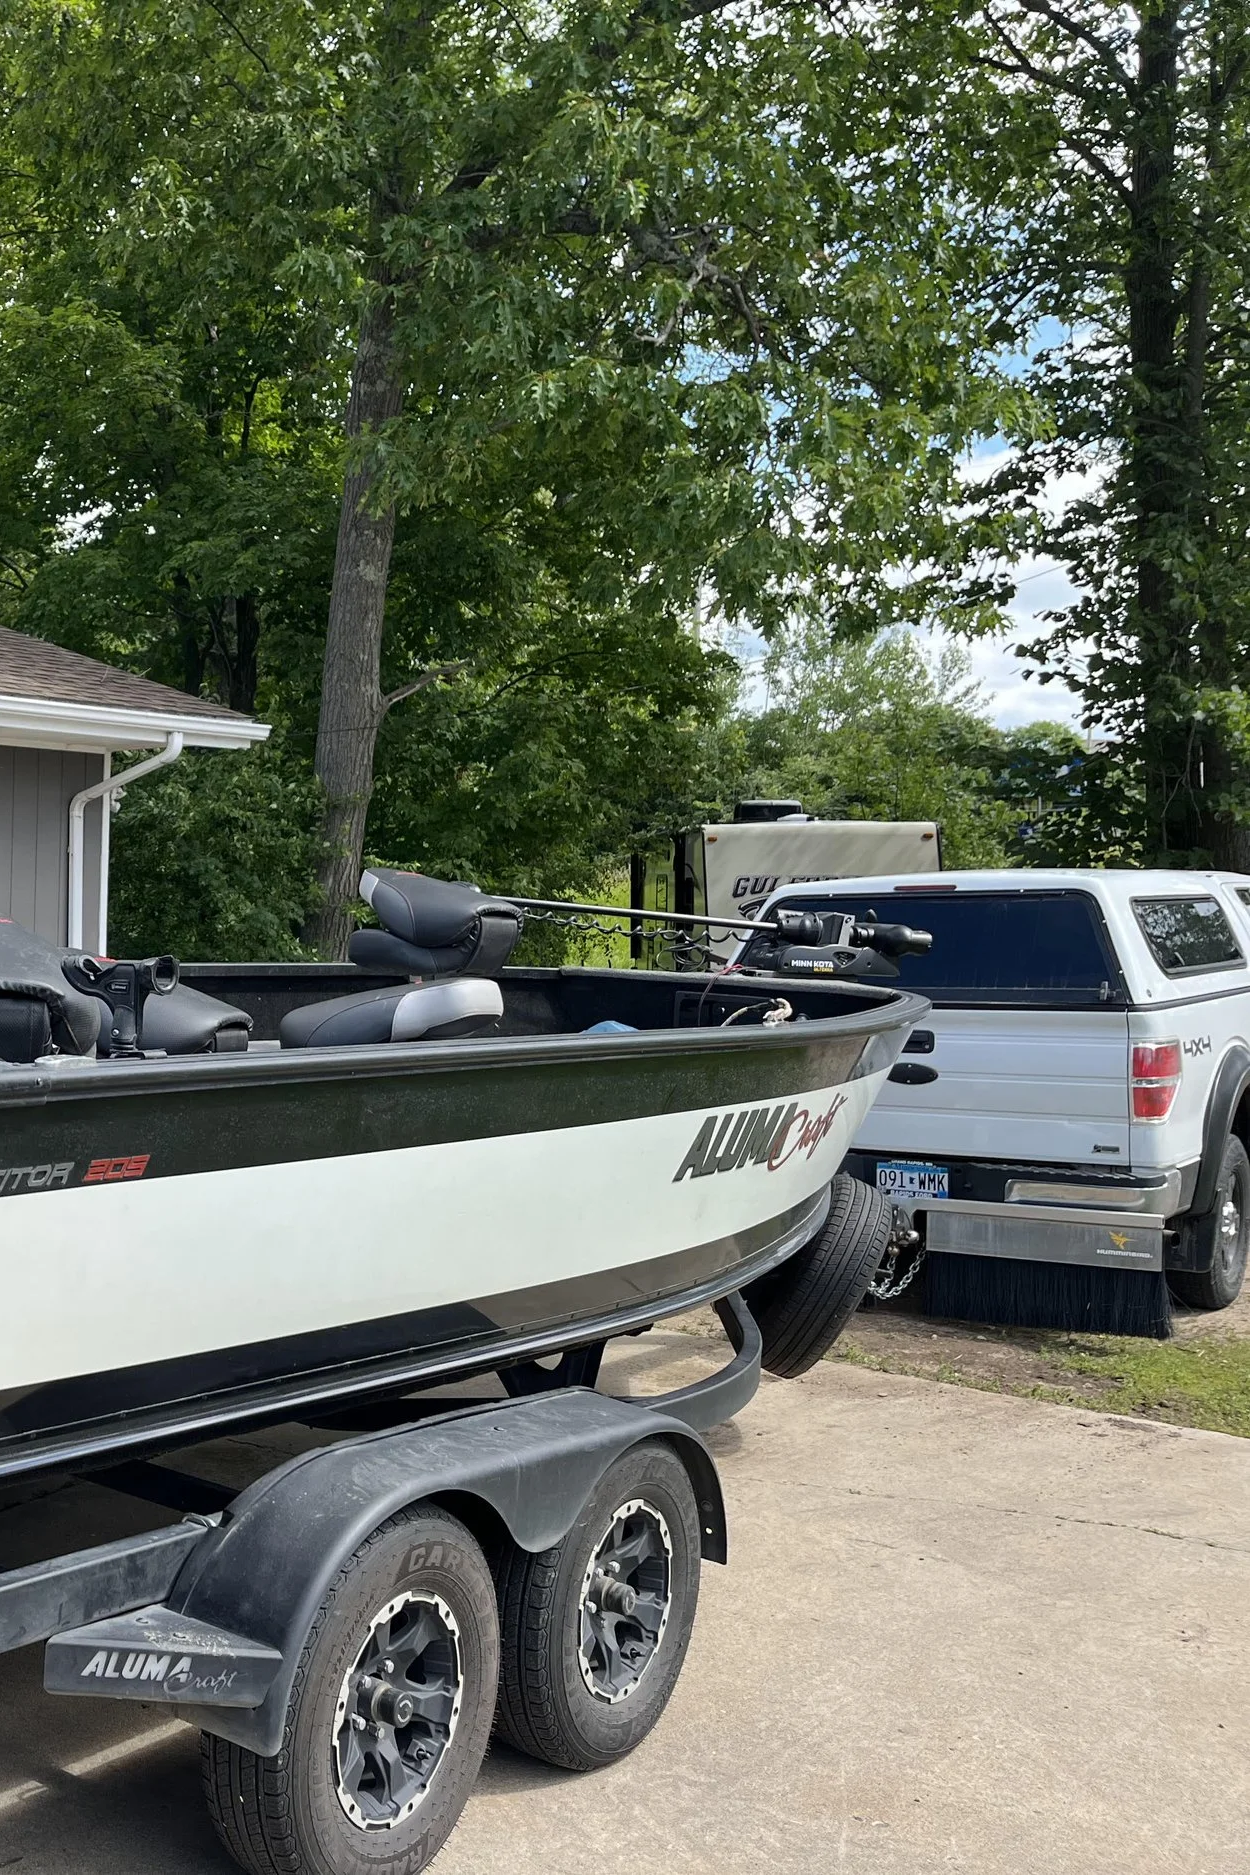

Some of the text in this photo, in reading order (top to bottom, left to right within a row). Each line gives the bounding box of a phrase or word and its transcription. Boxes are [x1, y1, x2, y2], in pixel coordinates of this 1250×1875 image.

[791, 959, 834, 968] MINN KOTA
[879, 1169, 946, 1191] 091 WMK
